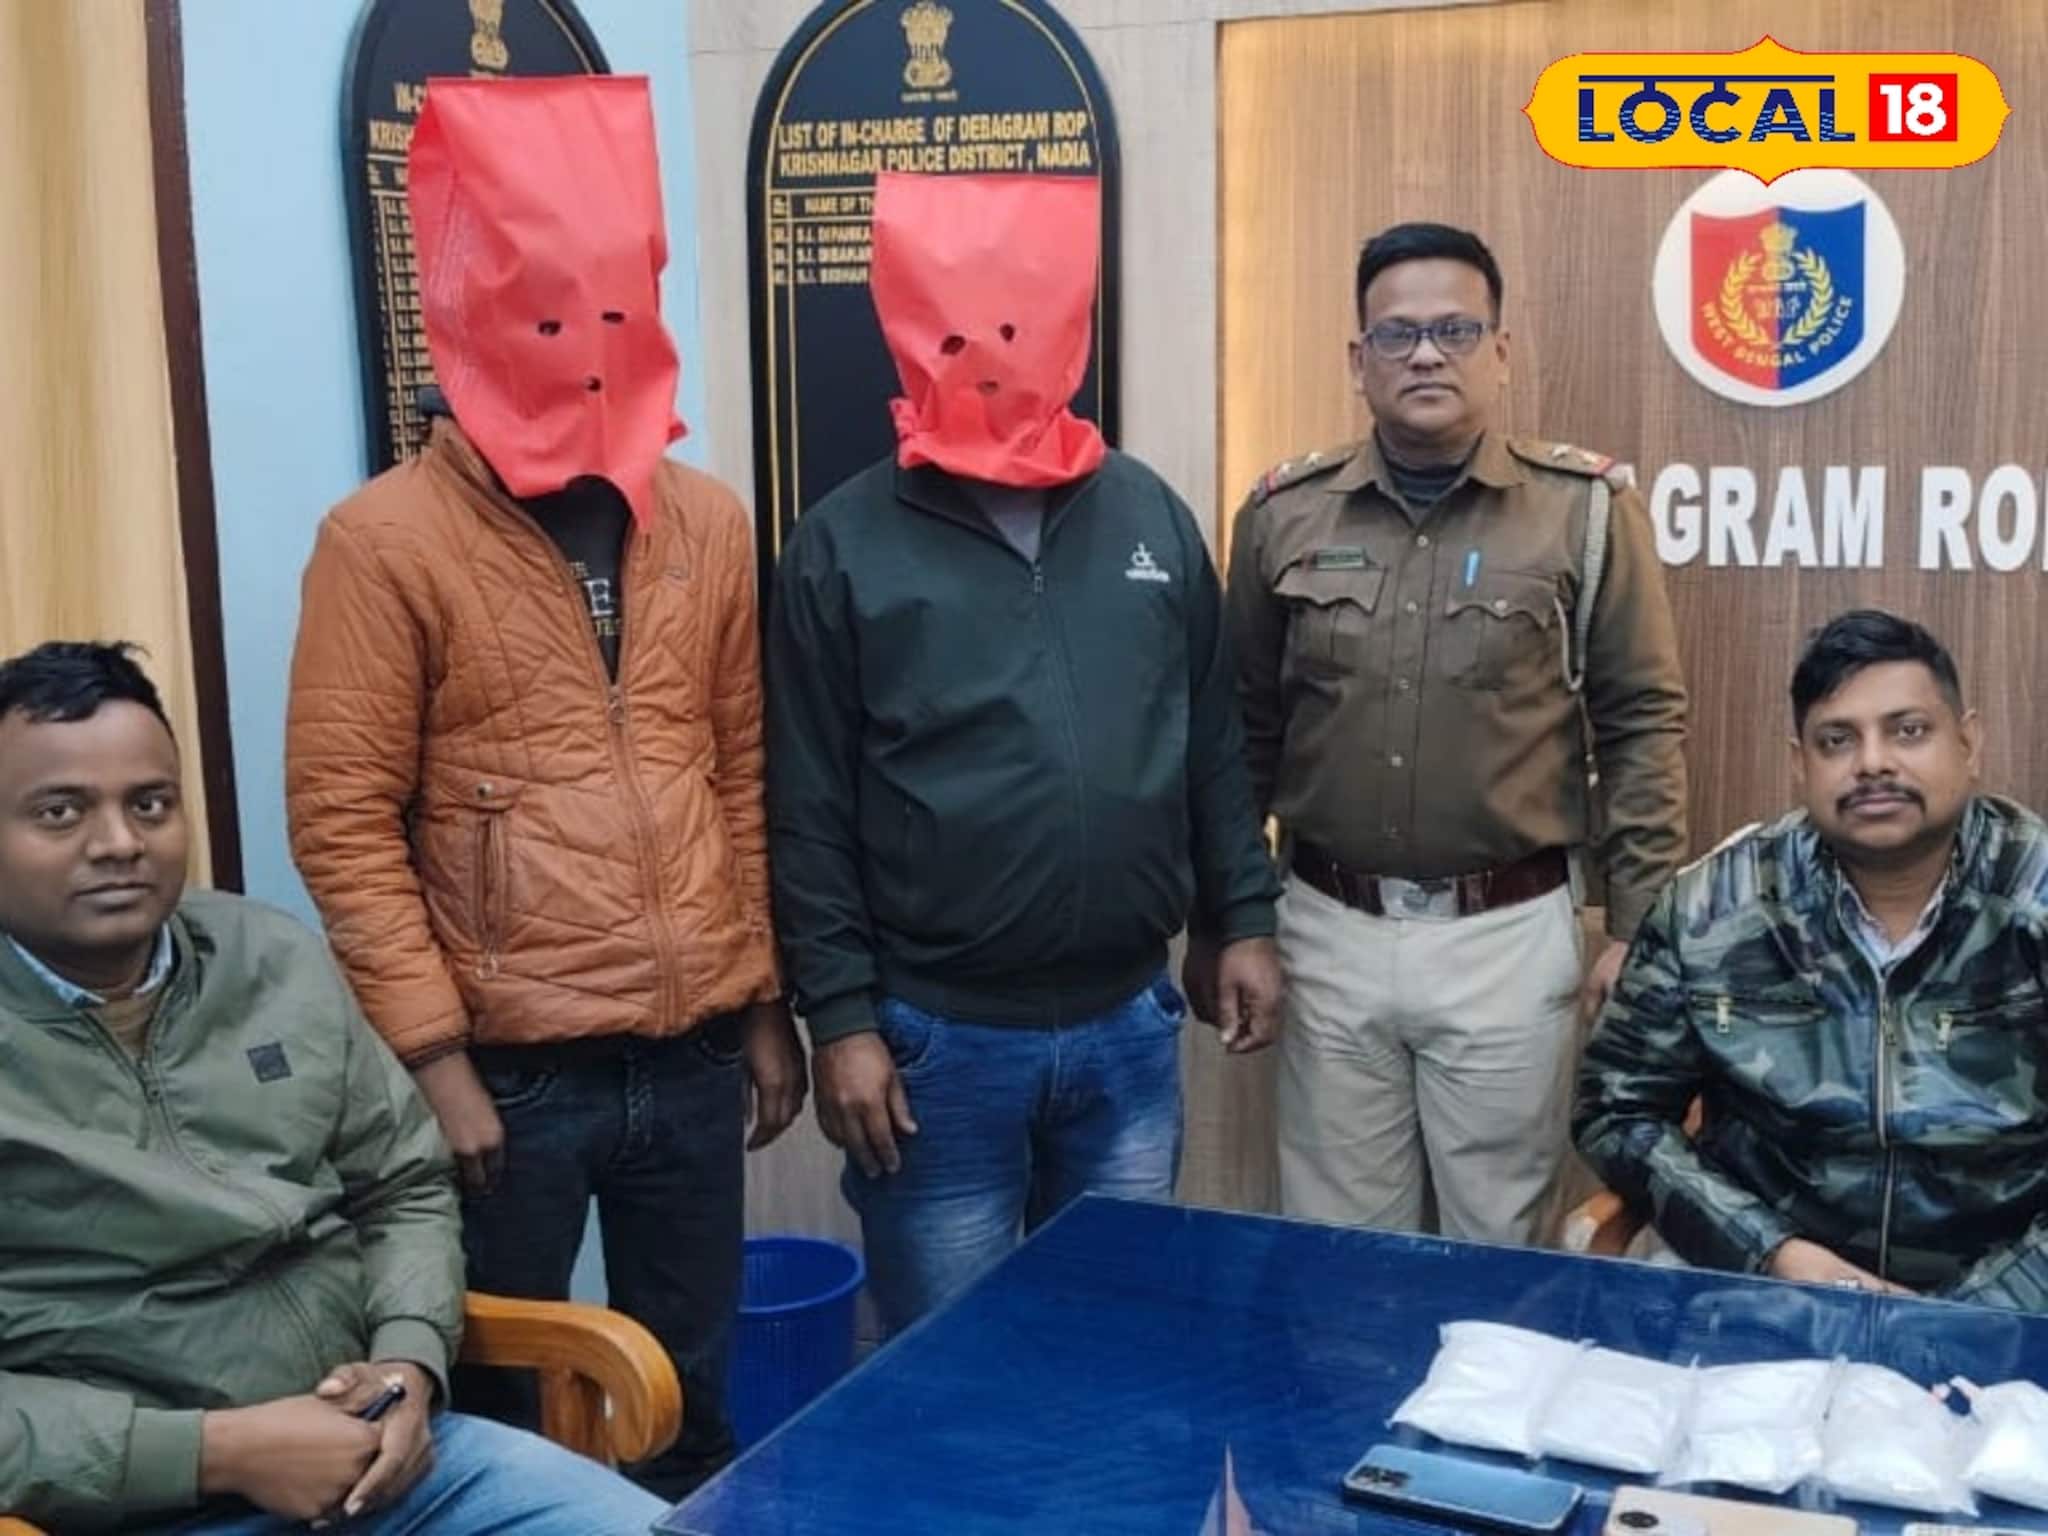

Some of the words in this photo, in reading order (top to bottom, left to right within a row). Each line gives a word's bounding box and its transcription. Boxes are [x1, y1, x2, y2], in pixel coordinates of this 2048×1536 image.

[778, 123, 813, 149] LIST
[816, 121, 839, 147] OF
[840, 116, 926, 145] IN-CHARGE
[933, 116, 955, 143] OF
[959, 111, 1049, 141] DEBAGRAM
[780, 148, 881, 177] KRISHNAGAR
[886, 145, 946, 173] POLICE
[949, 142, 1025, 171] DISTRICT
[1036, 140, 1092, 169] NADIA
[1702, 301, 1735, 348] WEST
[1733, 345, 1806, 367] BENGAL
[1808, 295, 1853, 355] POLICE
[1627, 463, 1886, 569] GRAM
[1918, 463, 2048, 571] RO
